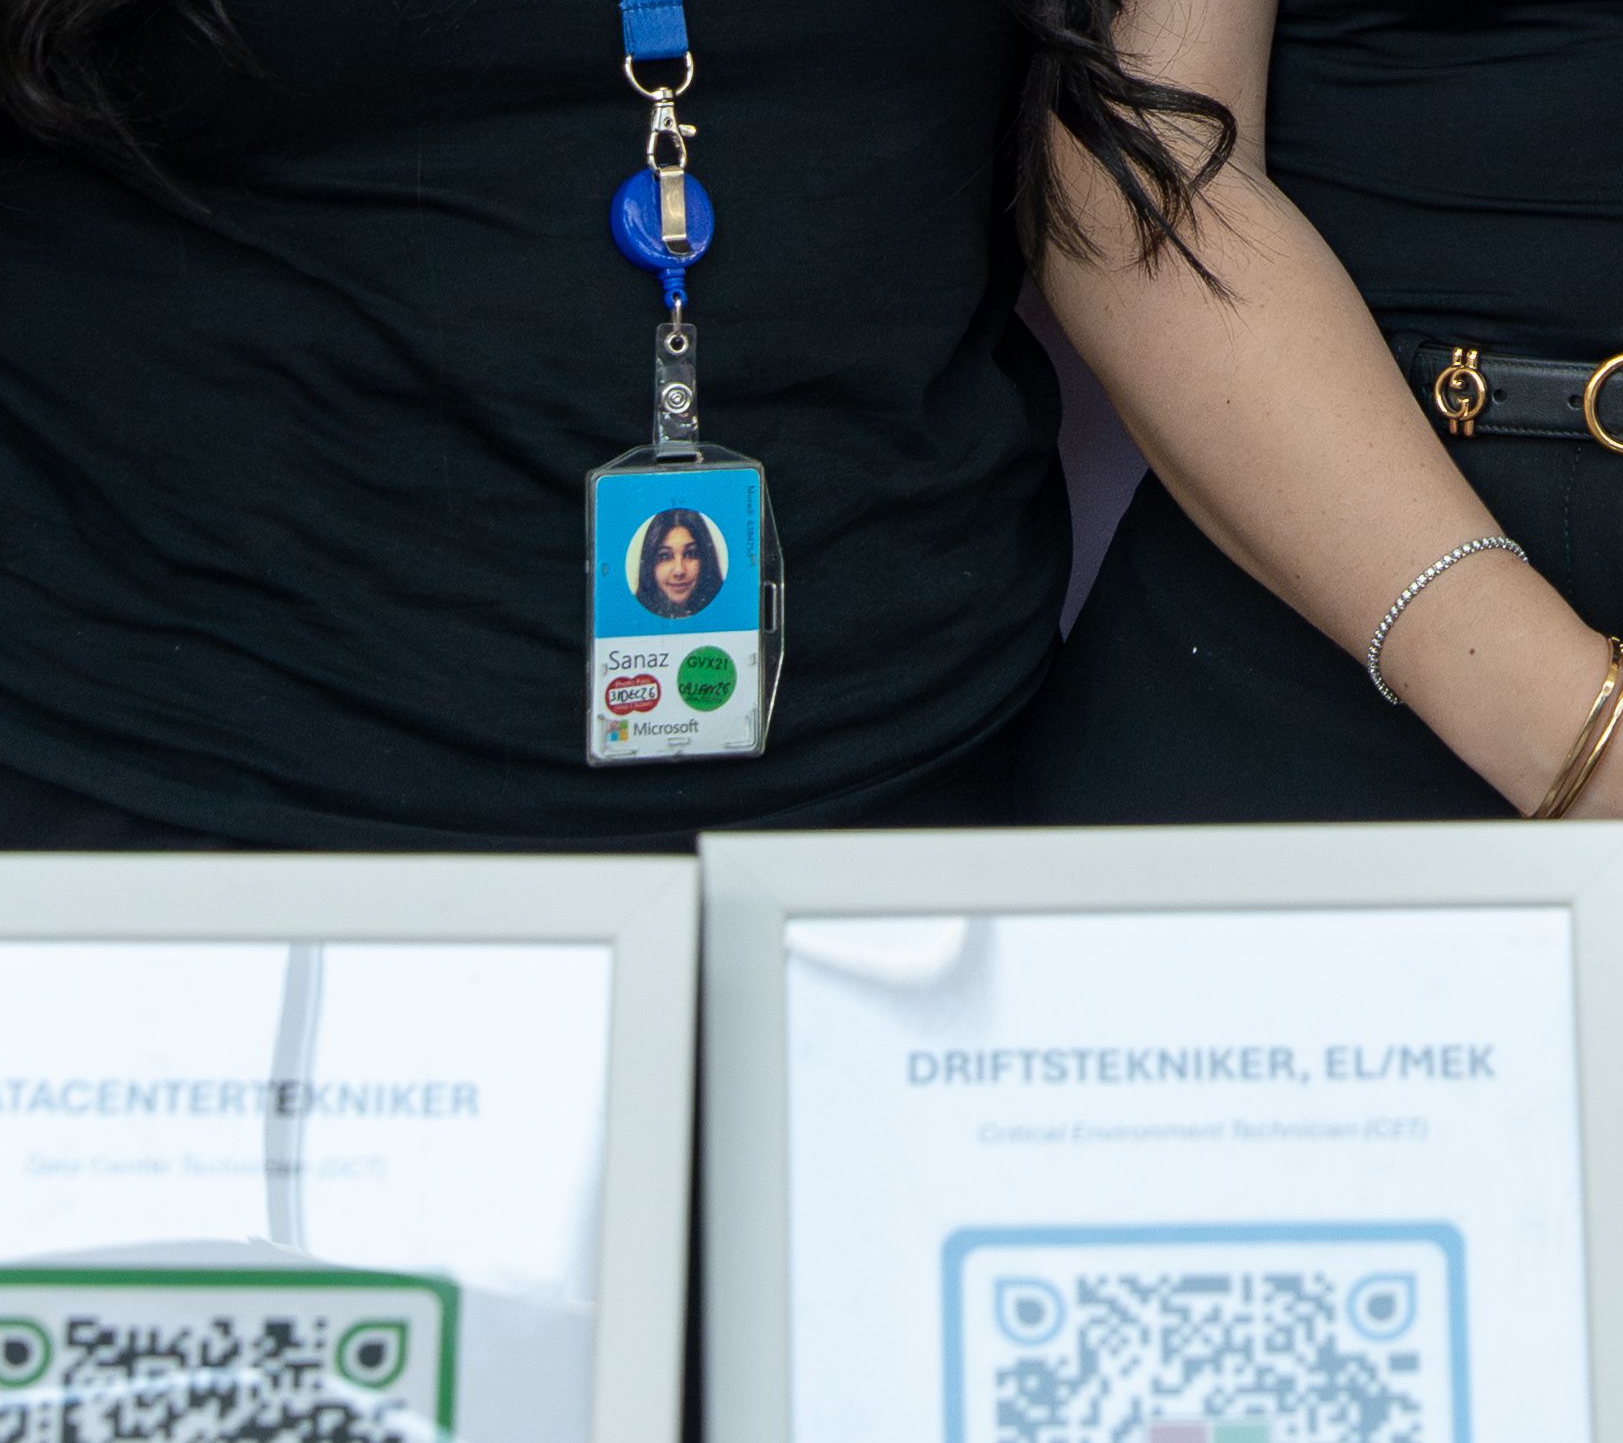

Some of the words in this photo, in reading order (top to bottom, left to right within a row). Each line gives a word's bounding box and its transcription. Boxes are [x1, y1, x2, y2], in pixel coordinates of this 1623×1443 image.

[608, 650, 670, 672] Sanaz
[633, 719, 700, 737] Microsoft
[905, 1044, 1312, 1089] DRIFTSTEKNIKER,
[1323, 1044, 1498, 1082] EL/MEK
